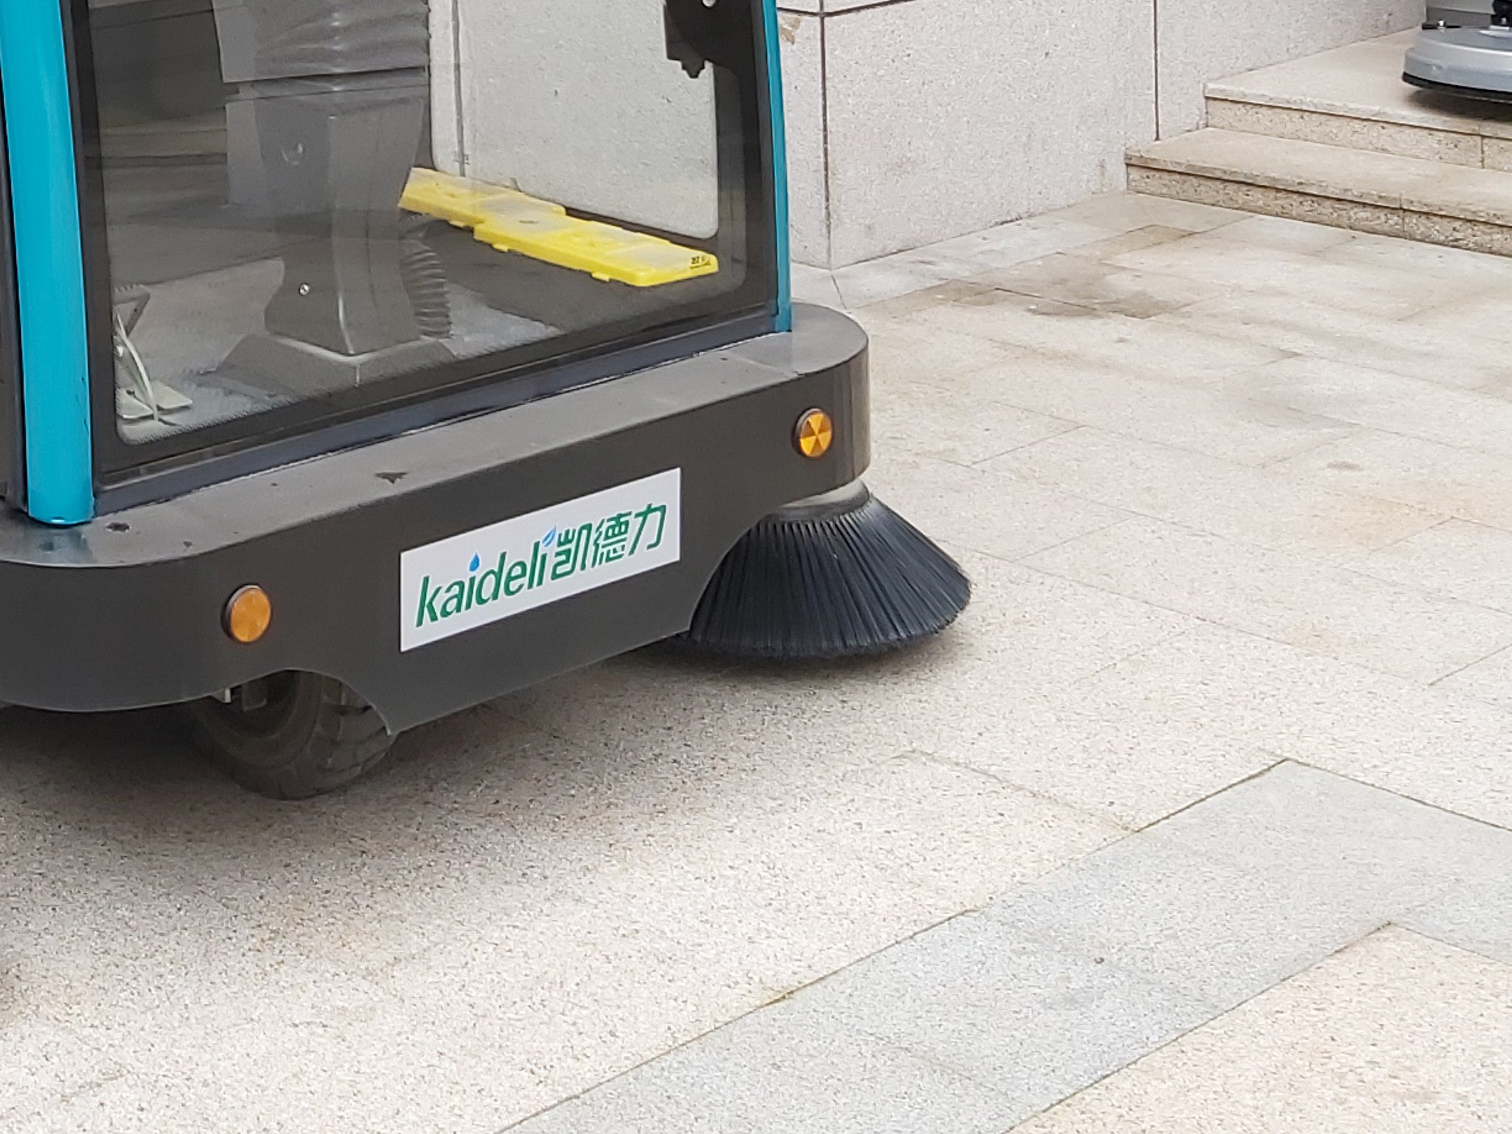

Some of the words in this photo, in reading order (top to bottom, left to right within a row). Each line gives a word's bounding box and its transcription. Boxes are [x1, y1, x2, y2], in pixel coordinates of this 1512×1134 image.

[415, 528, 554, 628] kaideli
[550, 503, 667, 581] 凯德力
